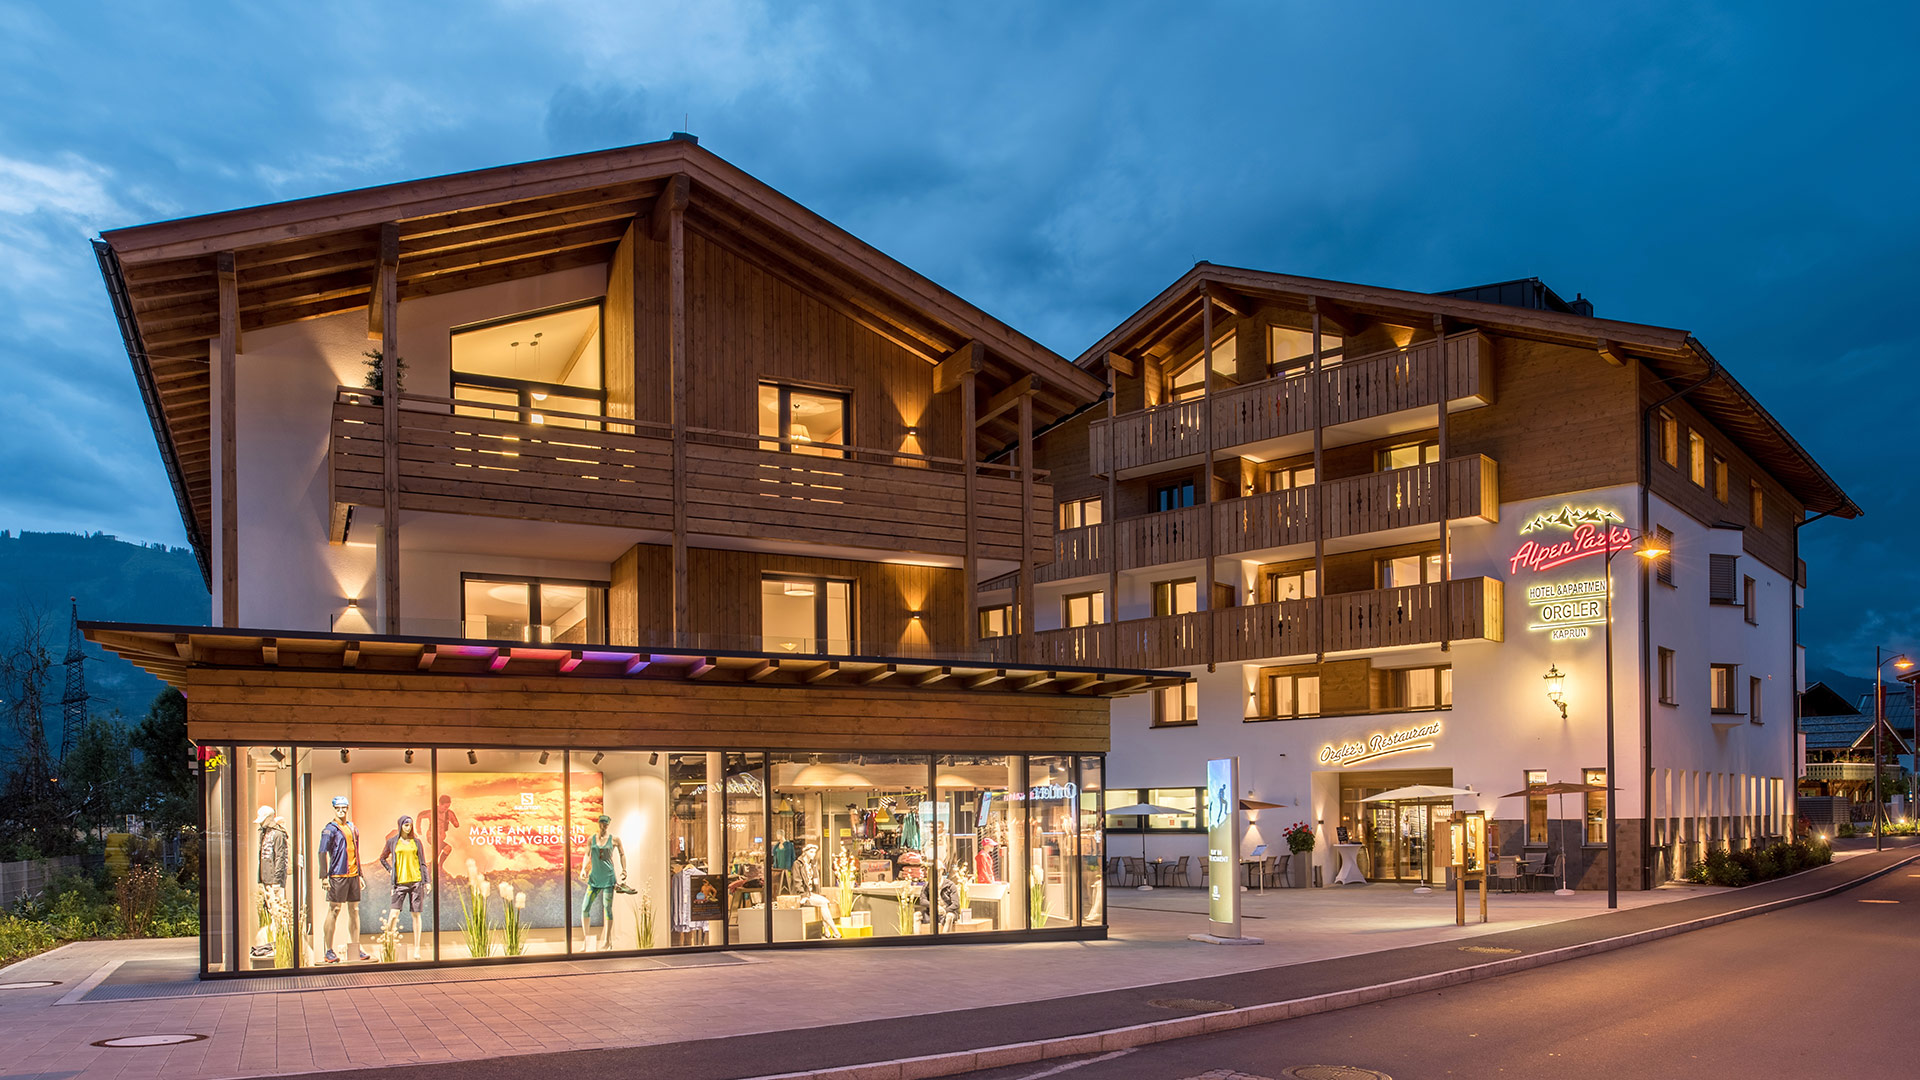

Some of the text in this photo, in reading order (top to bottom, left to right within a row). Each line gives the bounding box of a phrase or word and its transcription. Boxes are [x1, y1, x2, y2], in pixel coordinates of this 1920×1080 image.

[1509, 523, 1632, 576] Alpen Parks
[1529, 586, 1555, 598] HOTEL
[1542, 601, 1599, 620] ORGLER
[1552, 627, 1587, 639] KAPRUN
[1320, 722, 1440, 762] Orgler's Restaurant
[469, 826, 504, 835] MAKE
[507, 826, 533, 835] ANY
[468, 836, 502, 845] YOUR
